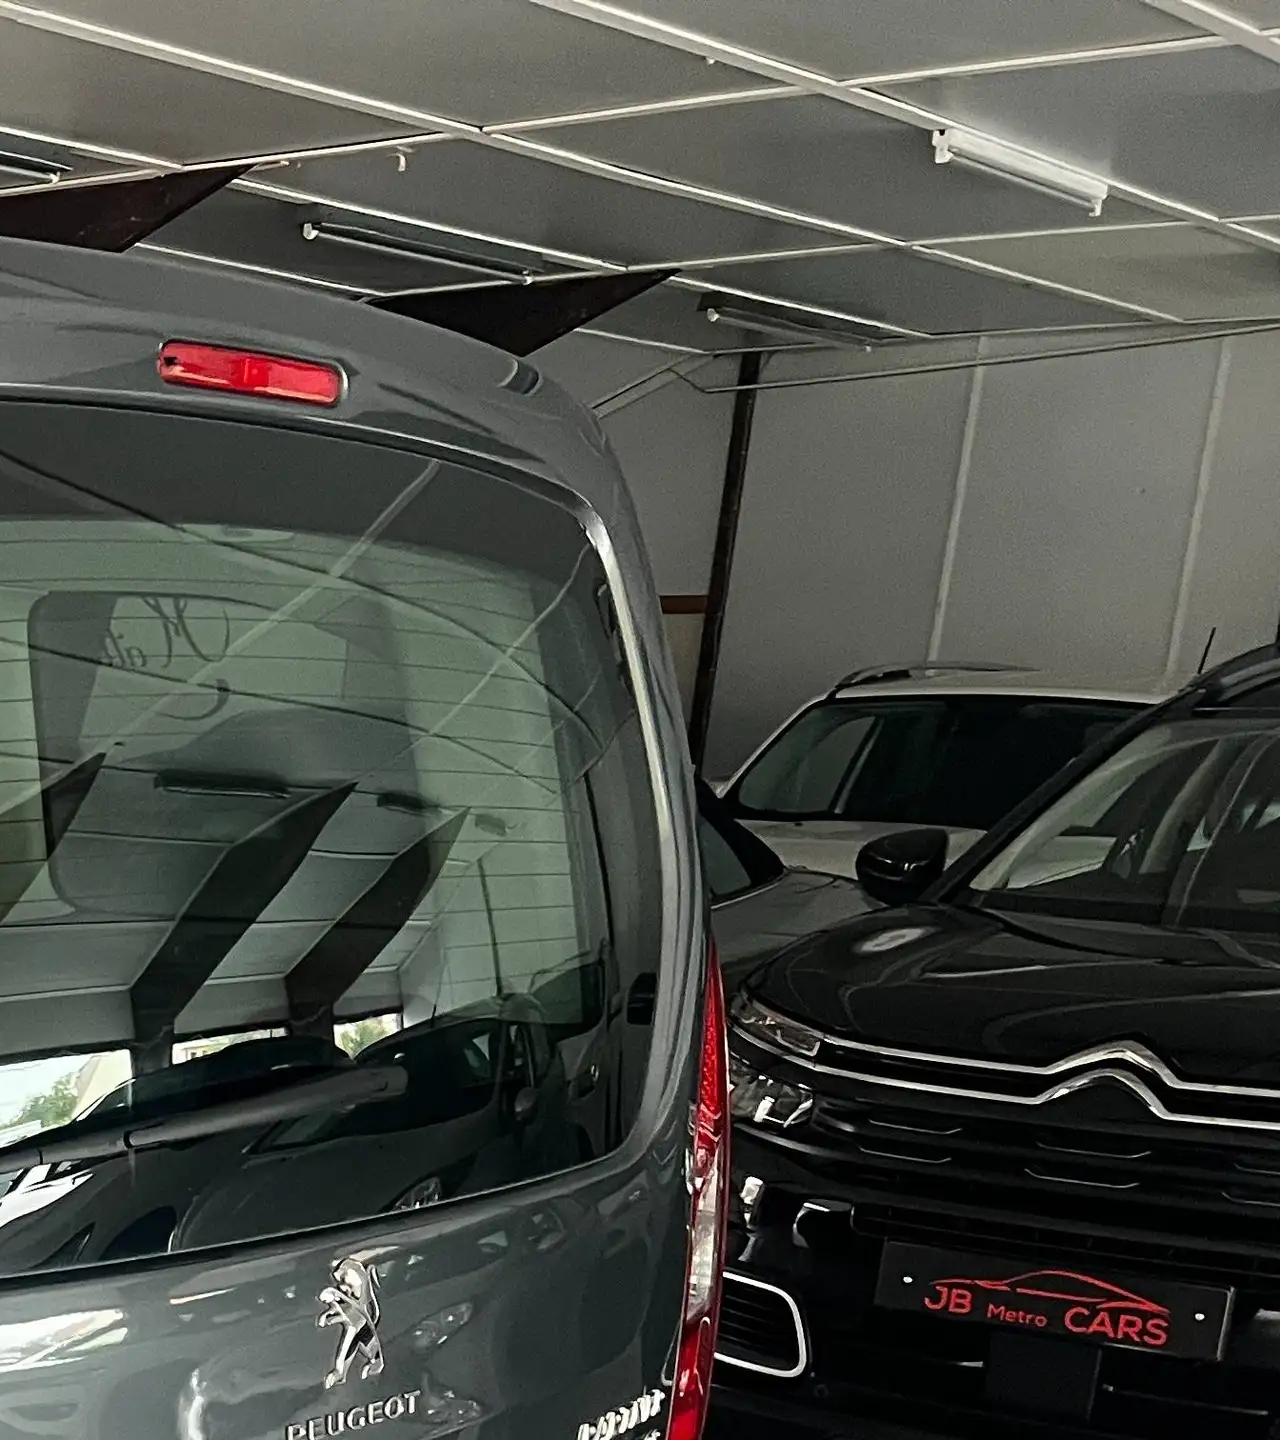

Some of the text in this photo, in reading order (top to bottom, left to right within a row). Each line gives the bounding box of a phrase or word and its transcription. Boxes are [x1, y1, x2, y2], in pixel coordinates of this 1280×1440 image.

[924, 1284, 1169, 1346] JB Metro CARS
